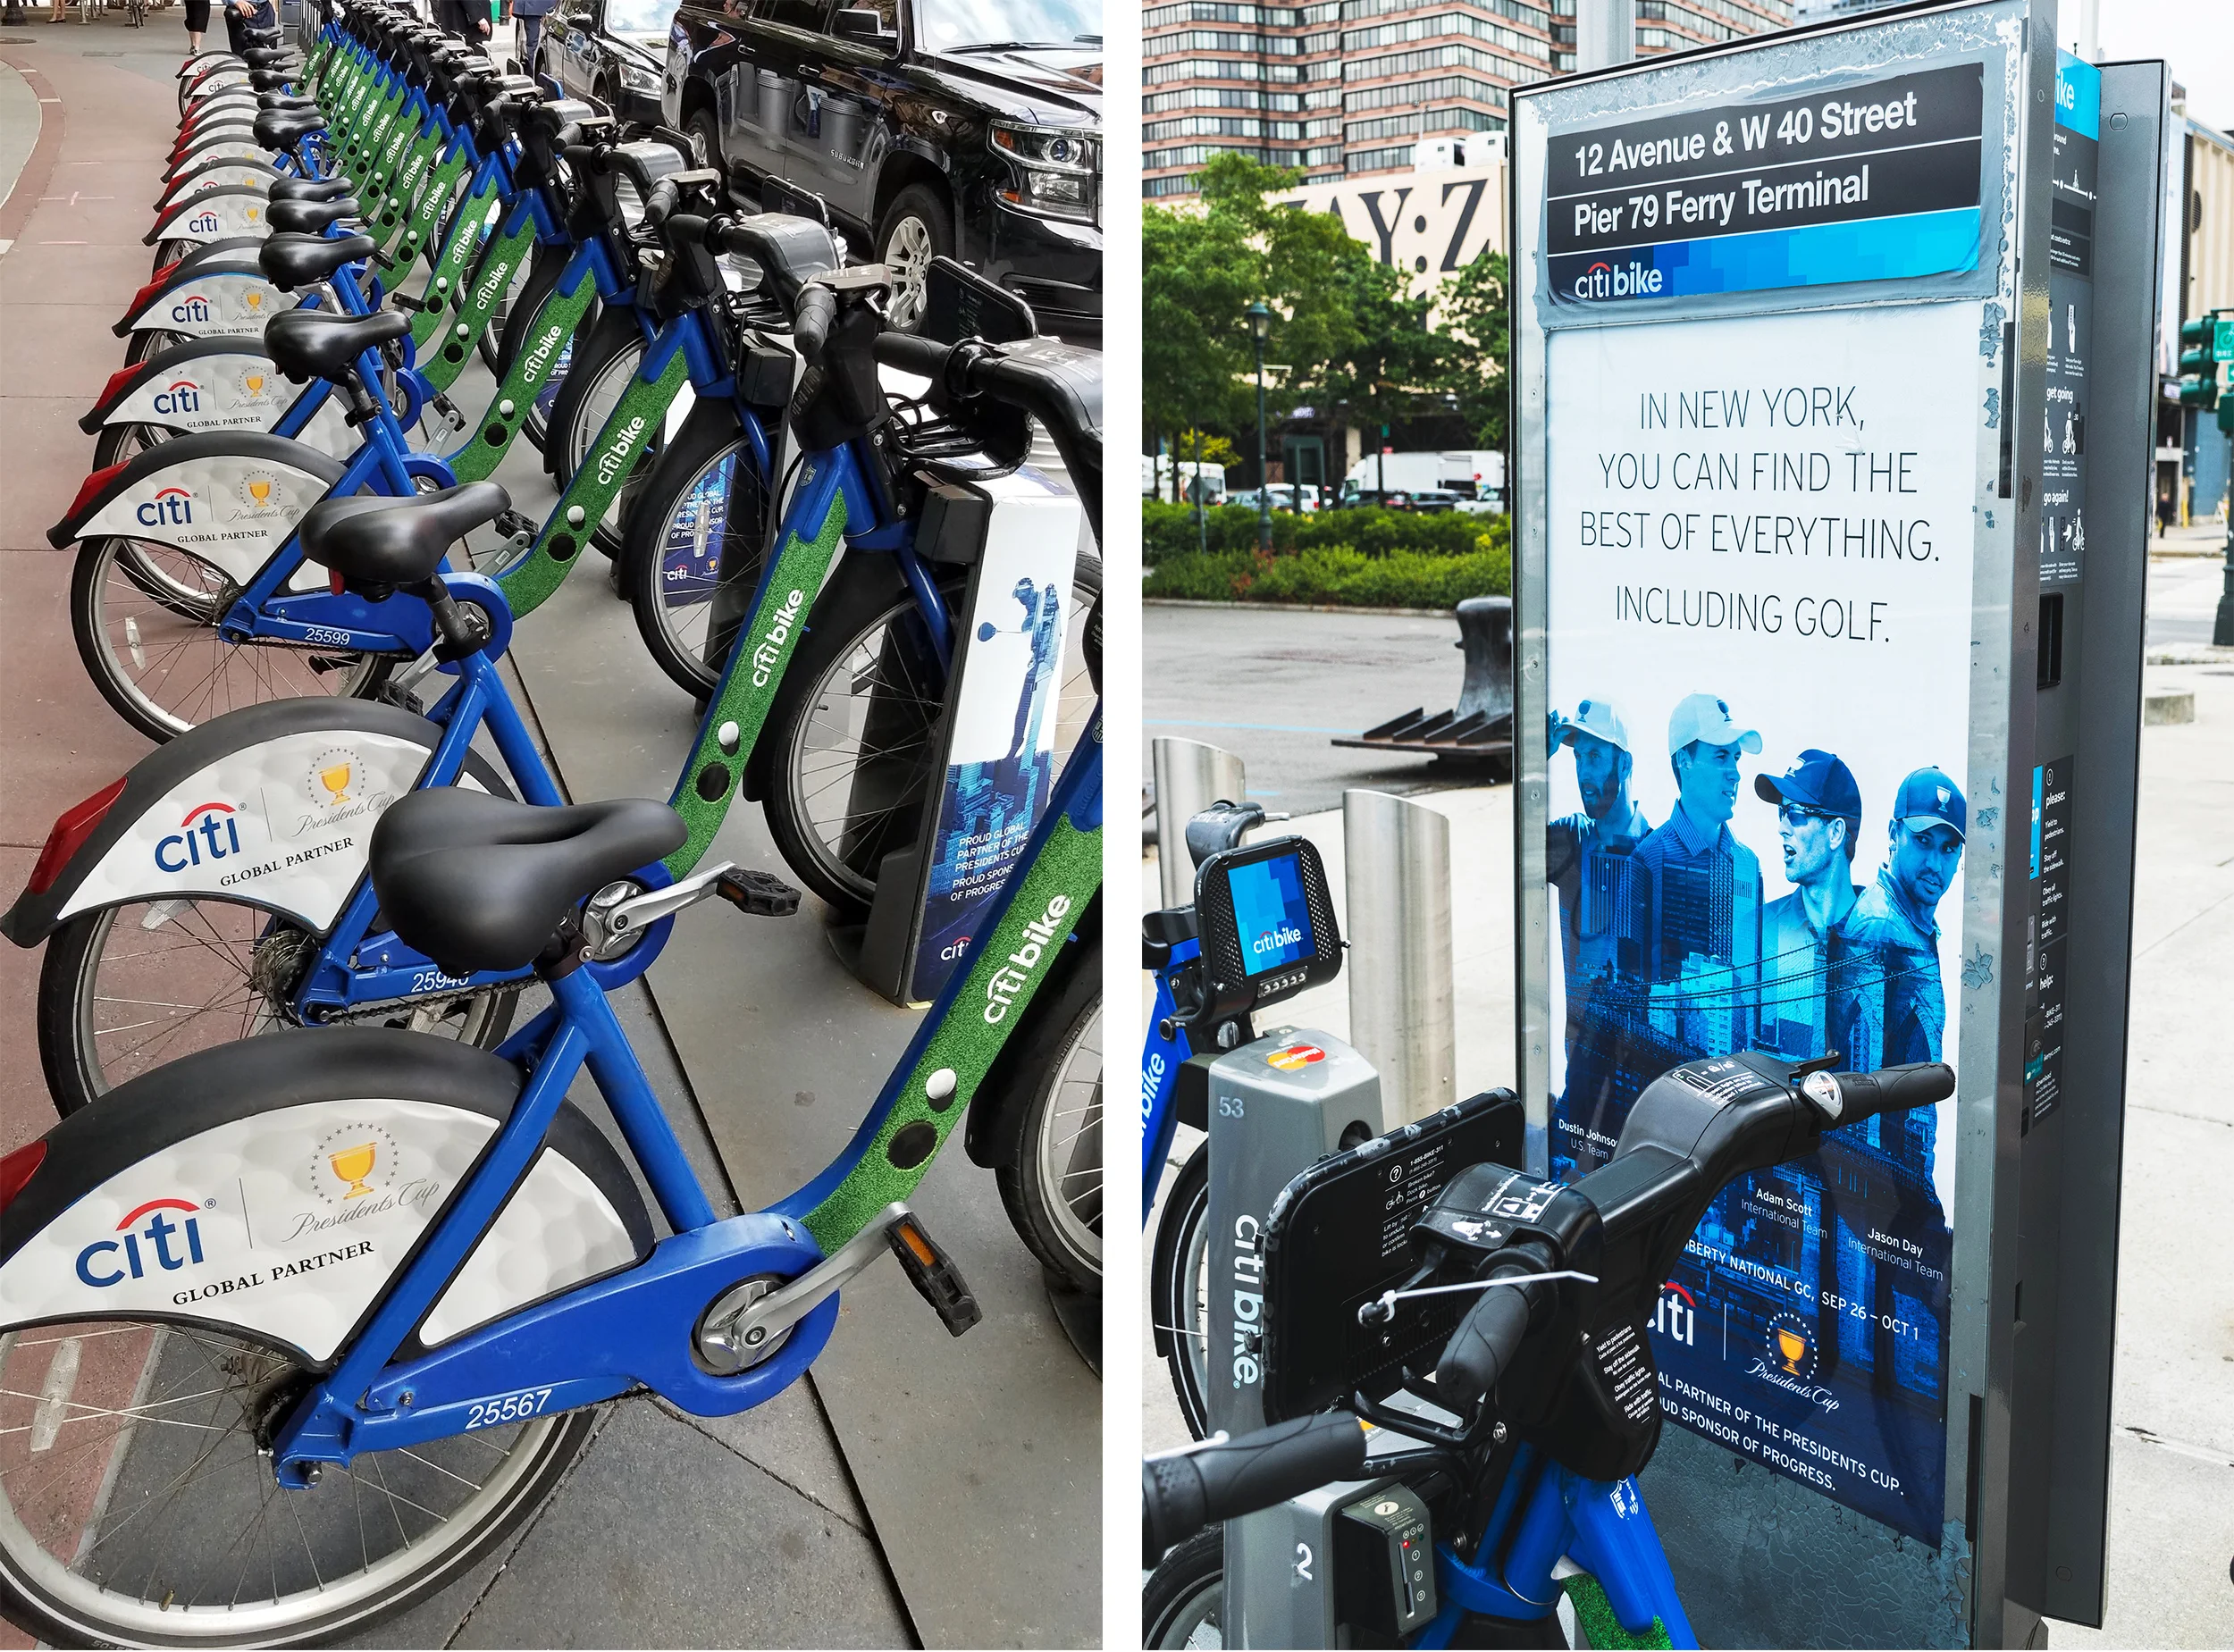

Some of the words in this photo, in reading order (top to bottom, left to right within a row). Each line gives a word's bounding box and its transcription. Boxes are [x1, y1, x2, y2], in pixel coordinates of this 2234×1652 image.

[2055, 71, 2075, 111] ike
[1575, 143, 1604, 177] 12
[1608, 130, 1705, 173] Avenue
[1712, 122, 1734, 157] &
[1739, 114, 1772, 152] W
[1776, 107, 1814, 146] 40
[1819, 91, 1918, 140] Street
[1573, 199, 1625, 236] Pier
[1628, 195, 1661, 230] 79
[1665, 184, 1736, 227] Ferry
[1741, 164, 1869, 216] Terminal
[189, 211, 218, 232] citi
[172, 297, 209, 323] citi
[154, 381, 199, 415] citi
[227, 398, 269, 409] Presidents
[1641, 391, 1667, 429] IN
[1680, 390, 1750, 429] NEW
[1762, 386, 1864, 431] YORK,
[2057, 386, 2073, 404] going
[187, 418, 220, 428] GLOBAL
[223, 416, 261, 425] PARTNER
[1599, 453, 1660, 490] YOU
[1673, 452, 1738, 491] CAN
[1753, 452, 1830, 491] FIND
[1844, 452, 1918, 493] THE
[137, 488, 192, 527] citi
[227, 508, 279, 522] Presidents
[177, 534, 218, 543] GLOBAL
[223, 529, 268, 541] PARTNER
[1581, 511, 1651, 549] BEST
[1662, 513, 1701, 550] OF
[1712, 515, 1939, 562] EVERYTHING.
[1617, 586, 1782, 633] INCLUDING
[1795, 597, 1889, 643] GOLF.
[304, 627, 350, 645] 25599
[291, 807, 365, 838] Presidents
[365, 792, 395, 814] Cup
[2045, 790, 2066, 809] please:
[154, 802, 240, 874] citi
[958, 843, 999, 860] PARTNER
[1001, 838, 1013, 849] OF
[1013, 831, 1029, 843] THE
[960, 833, 991, 847] PROUD
[994, 822, 1024, 838] GLOBAL
[220, 861, 281, 887] GLOBAL
[286, 836, 354, 868] PARTNER
[953, 873, 985, 888] PROUD
[987, 863, 1014, 880] SPONS
[955, 852, 1010, 872] PRESIDENTS
[951, 892, 963, 901] OF
[940, 936, 970, 961] cit
[1276, 927, 1302, 947] bike
[1219, 1095, 1244, 1119] 53
[1558, 1119, 1584, 1136] Dustin
[1585, 1129, 1617, 1147] Johnso
[1571, 1138, 1585, 1152] U.S.
[1587, 1143, 1608, 1160] Team
[282, 1195, 396, 1243] Presidents
[397, 1178, 440, 1208] Cup
[1742, 1199, 1799, 1229] International
[1801, 1220, 1827, 1238] Team
[1757, 1188, 1784, 1206] Adam
[1786, 1199, 1812, 1217] Scott
[75, 1199, 204, 1287] citi
[1848, 1237, 1911, 1270] International
[1915, 1261, 1943, 1281] Team
[1868, 1228, 1899, 1248] Jason
[1903, 1239, 1923, 1258] Day
[172, 1273, 265, 1306] GLOBAL
[272, 1240, 375, 1281] PARTNER
[1685, 1239, 1726, 1264] BERTY
[1730, 1250, 1791, 1291] NATIONAL
[1794, 1281, 1815, 1303] GC,
[1821, 1292, 1847, 1311] SEP
[1851, 1302, 1867, 1320] 26
[1882, 1315, 1909, 1337] OCT
[1914, 1327, 1919, 1340] 1
[1647, 1281, 1697, 1346] iti
[1596, 1342, 1607, 1352] Yield
[1610, 1326, 1632, 1346] pedestrians
[1603, 1364, 1613, 1374] Stay
[1744, 1357, 1812, 1398] Presidents
[1812, 1385, 1840, 1413] Cup
[1614, 1381, 1625, 1392] Obey
[465, 1388, 552, 1430] 25567
[1676, 1379, 1731, 1416] PARTNER
[1734, 1406, 1751, 1423] OF
[1755, 1415, 1780, 1438] THE
[1784, 1429, 1866, 1478] PRESIDENTS
[1870, 1470, 1904, 1496] CUP.
[1682, 1406, 1739, 1445] SPONSOR
[1743, 1436, 1759, 1453] OF
[1763, 1445, 1836, 1491] PROGRESS.
[1294, 1542, 1314, 1581] 2
